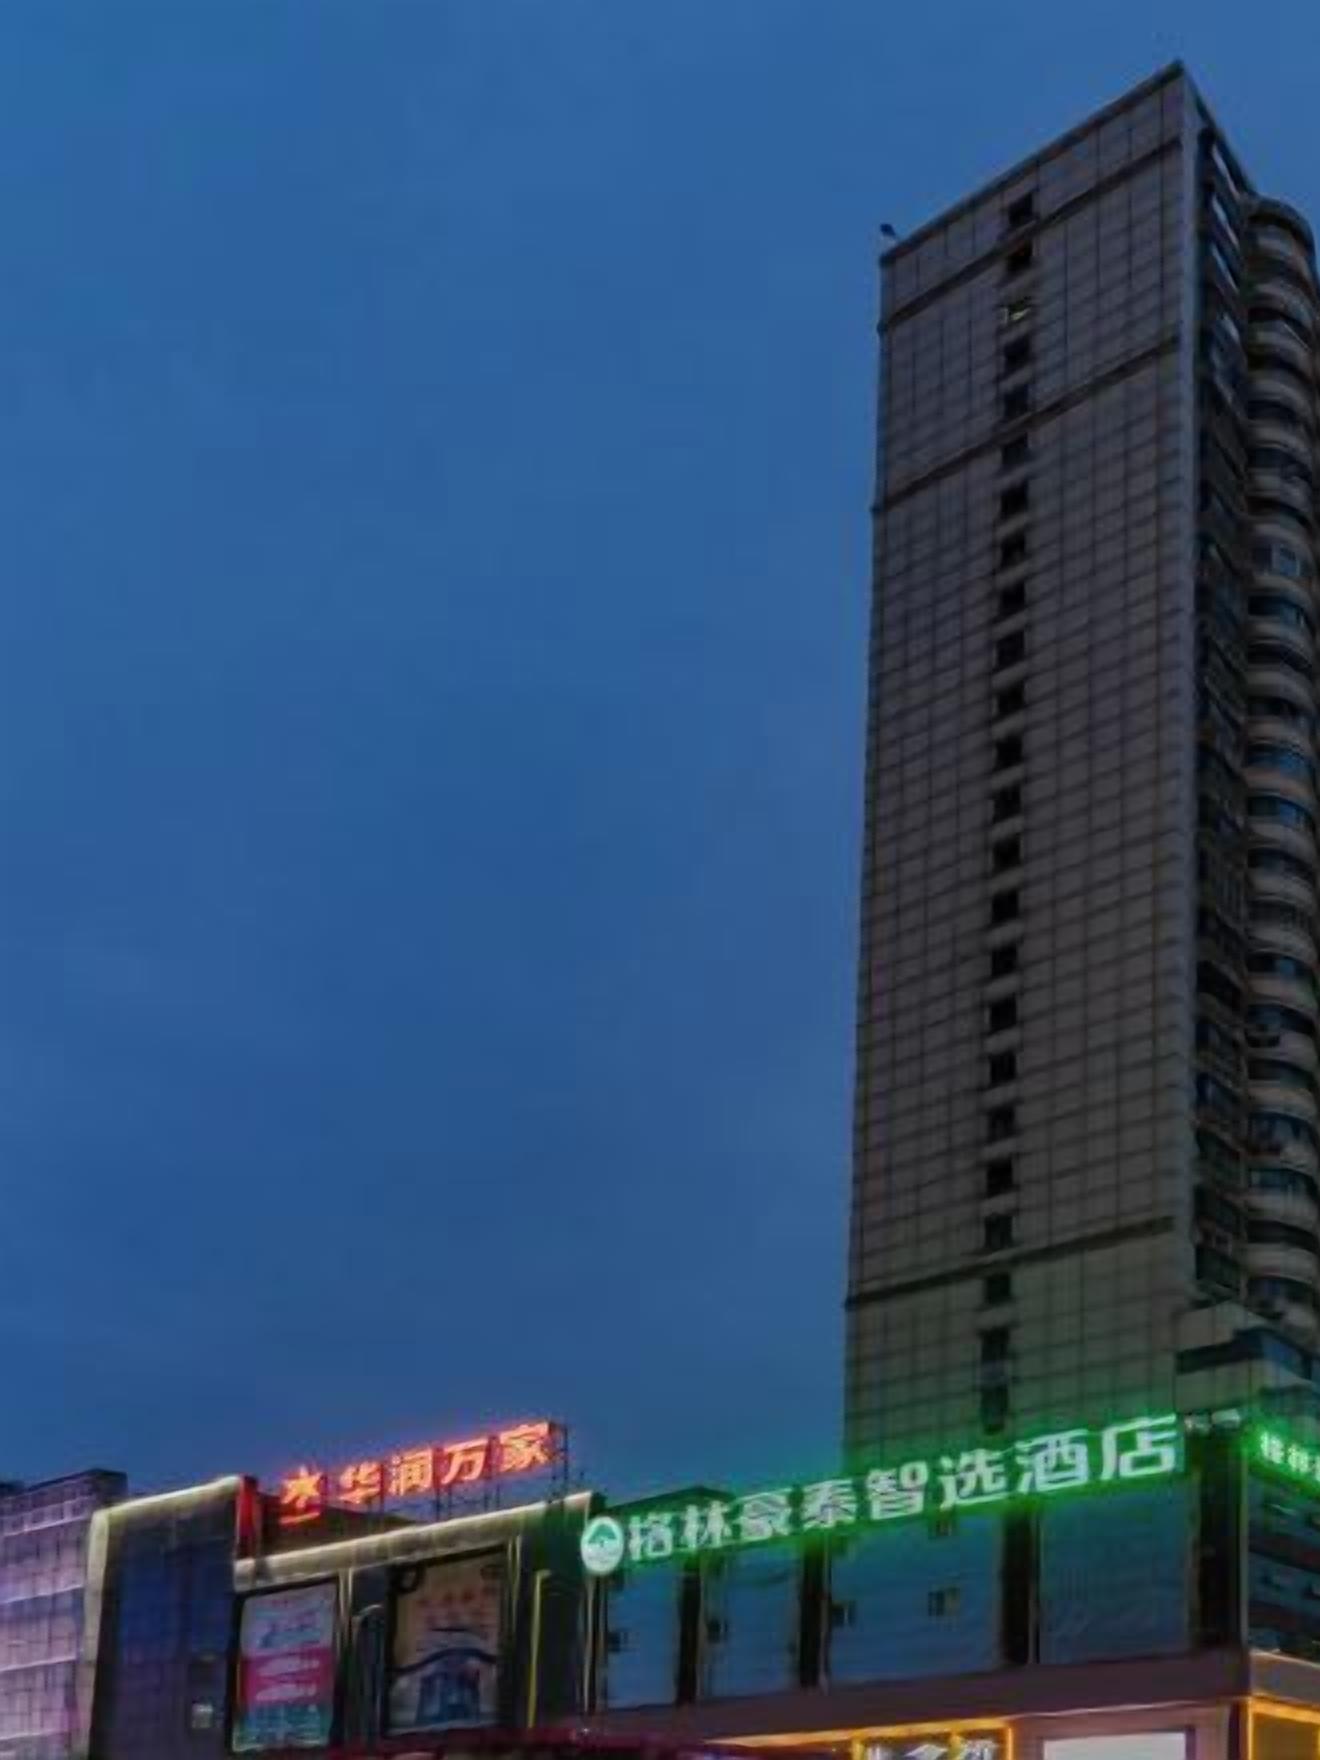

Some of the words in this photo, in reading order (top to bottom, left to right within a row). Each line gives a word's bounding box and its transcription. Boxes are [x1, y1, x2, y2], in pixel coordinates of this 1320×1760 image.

[339, 1420, 551, 1505] 华润万家
[628, 1414, 1178, 1561] 格林豪泰智选酒店
